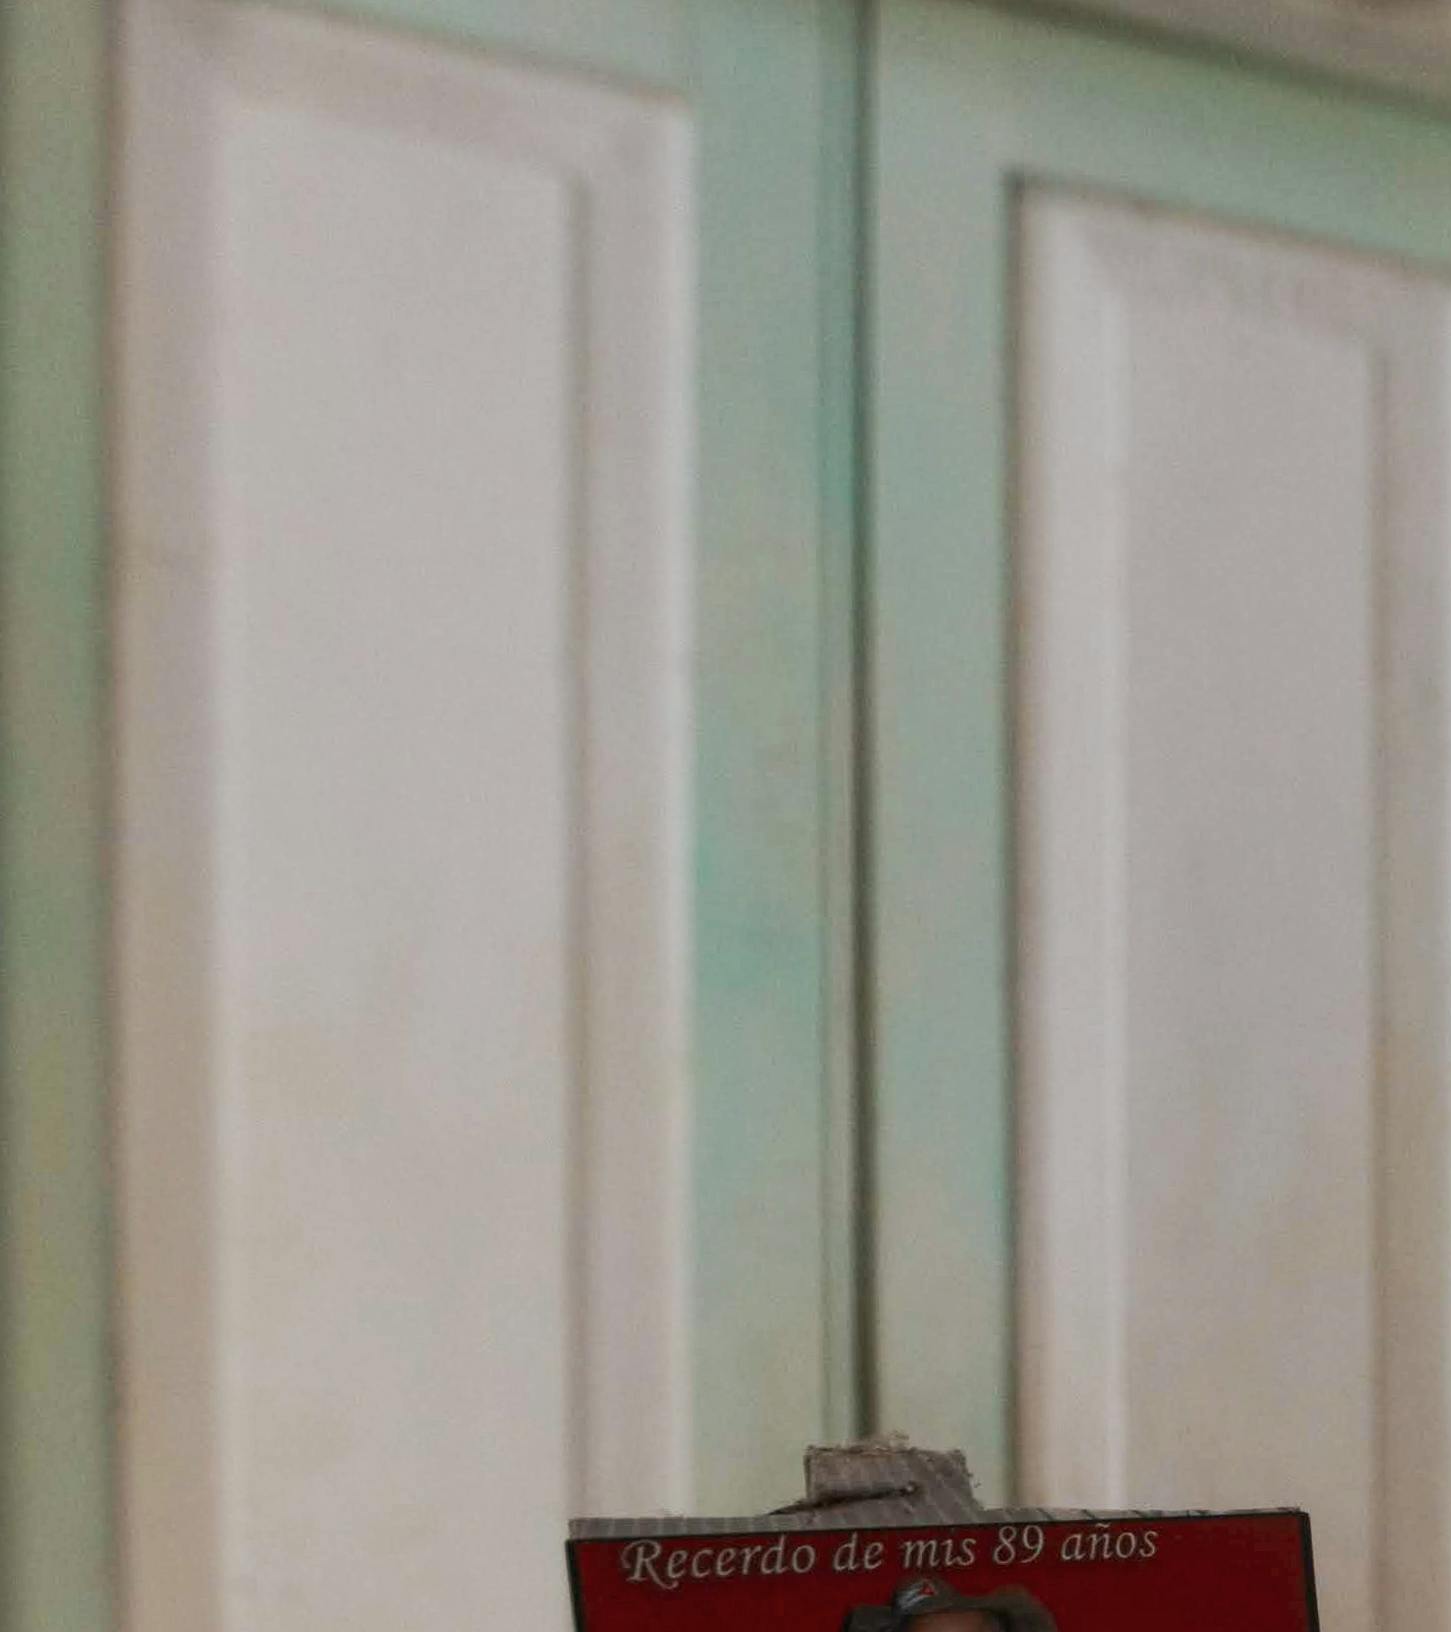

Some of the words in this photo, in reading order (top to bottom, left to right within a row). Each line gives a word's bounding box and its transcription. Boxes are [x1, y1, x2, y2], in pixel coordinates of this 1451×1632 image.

[622, 1535, 816, 1589] Recerdo
[833, 1534, 883, 1571] de
[904, 1536, 977, 1568] mis
[993, 1525, 1046, 1563] 89
[1062, 1522, 1159, 1561] años
